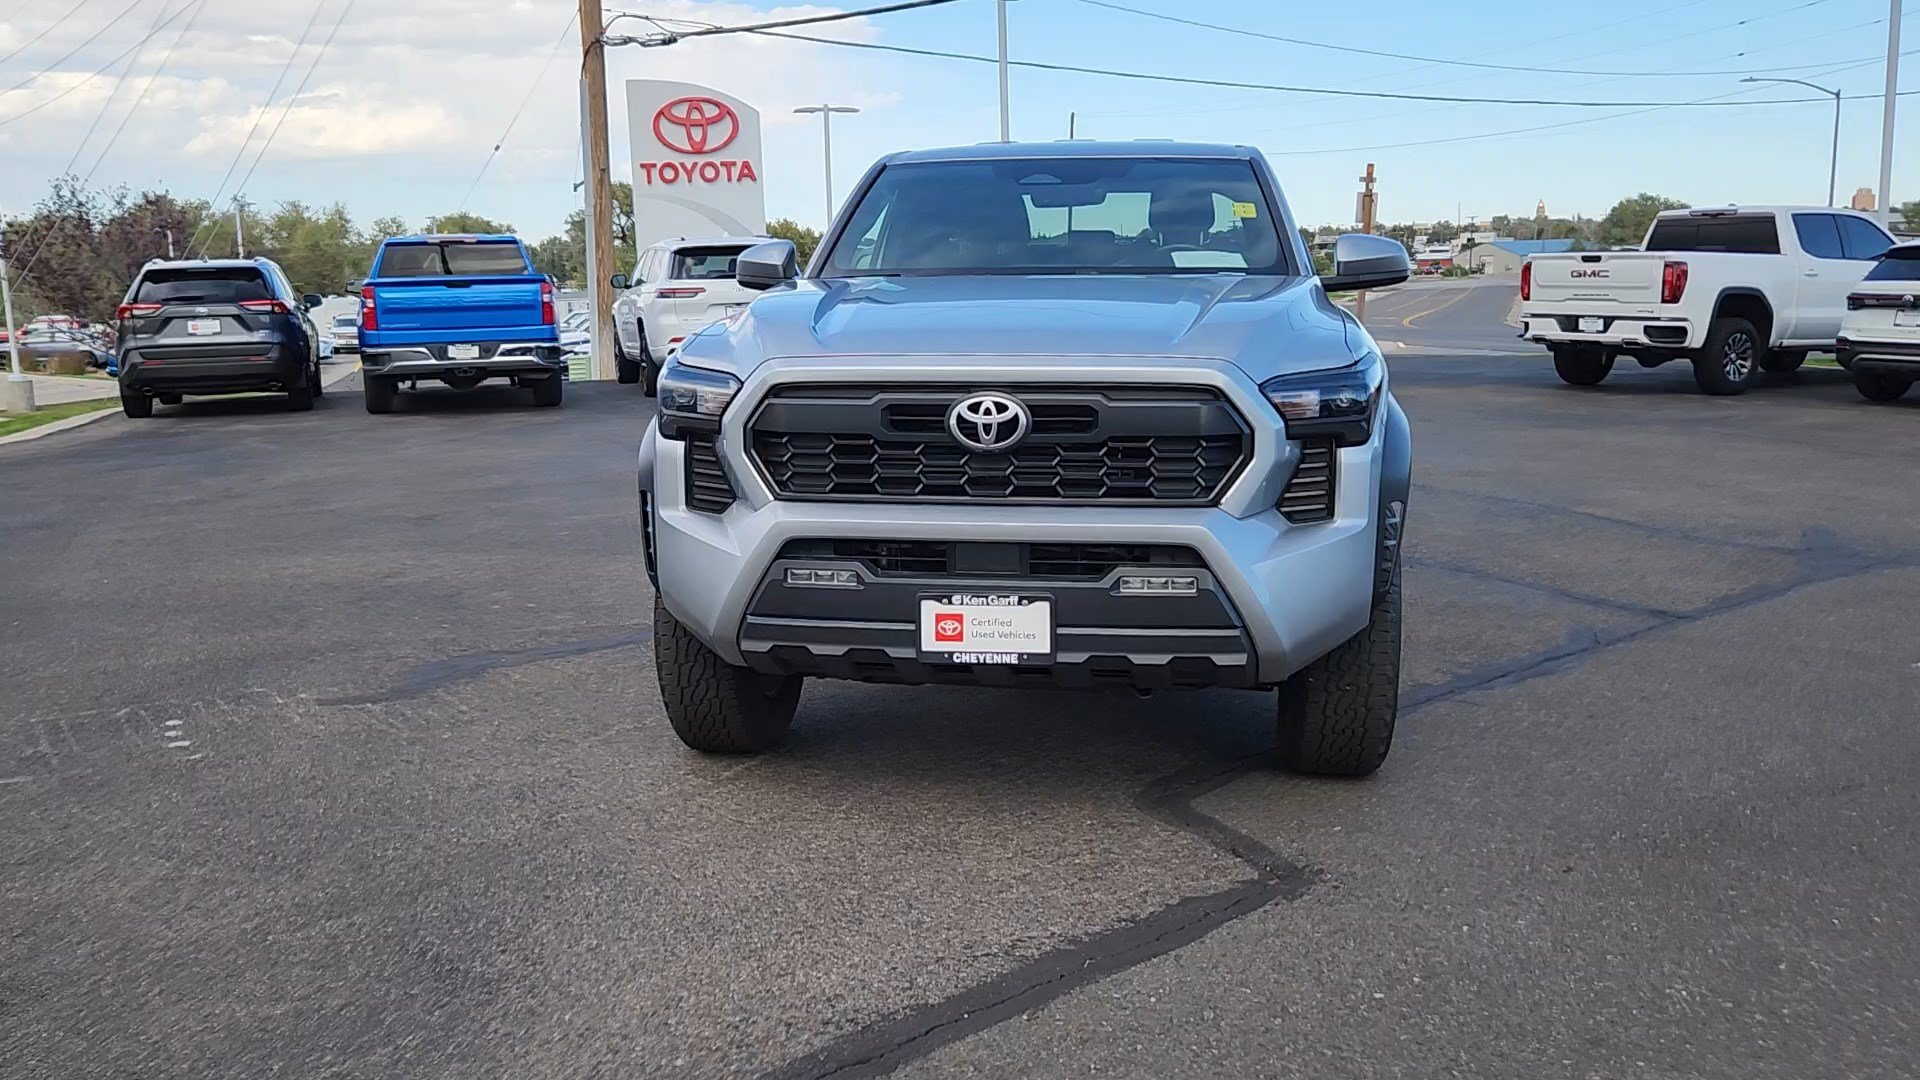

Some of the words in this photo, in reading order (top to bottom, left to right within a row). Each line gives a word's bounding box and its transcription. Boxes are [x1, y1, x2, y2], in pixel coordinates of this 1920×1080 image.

[640, 161, 757, 184] TOYOTA
[1570, 269, 1610, 278] GMC
[963, 595, 987, 606] Ken
[988, 595, 1018, 606] Garff
[971, 618, 1012, 627] Certified
[971, 630, 995, 639] Used
[997, 631, 1037, 640] Vehicles
[953, 653, 1018, 664] CHEYENNE
